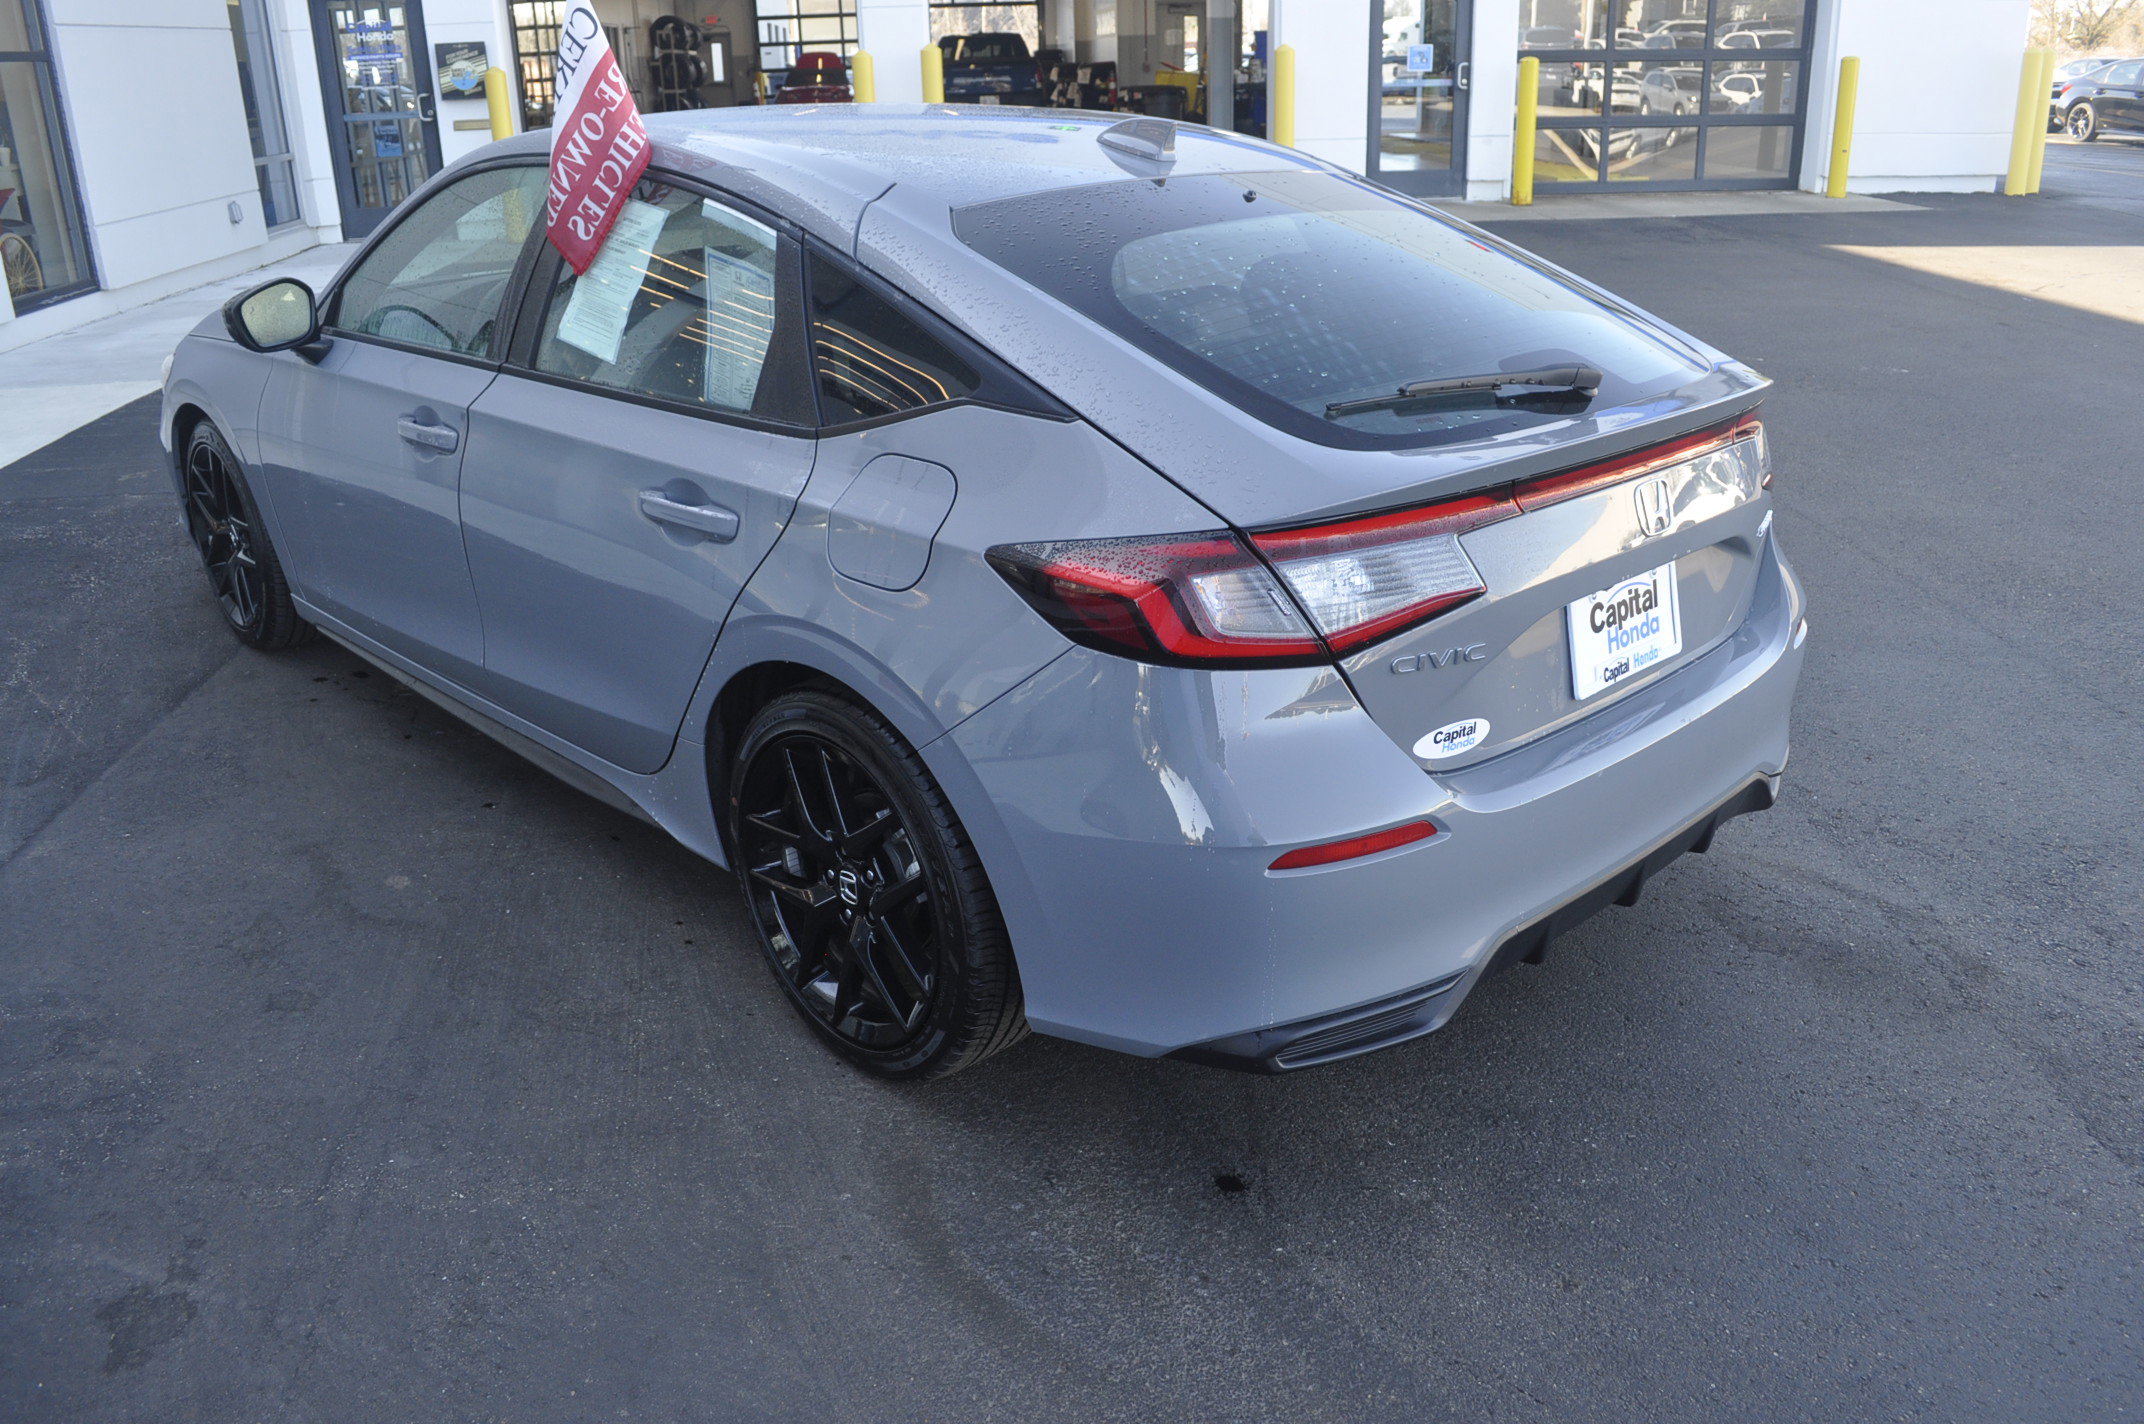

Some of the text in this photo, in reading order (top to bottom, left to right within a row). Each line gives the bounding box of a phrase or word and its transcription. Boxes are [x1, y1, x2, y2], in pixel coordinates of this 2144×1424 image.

[356, 30, 394, 42] Honda
[1590, 579, 1659, 634] Capital
[1607, 612, 1661, 655] Honda
[1390, 643, 1487, 675] CIVIC
[1603, 644, 1660, 683] Capital Honda
[1433, 721, 1478, 745] Capital
[1441, 736, 1476, 754] Honda
